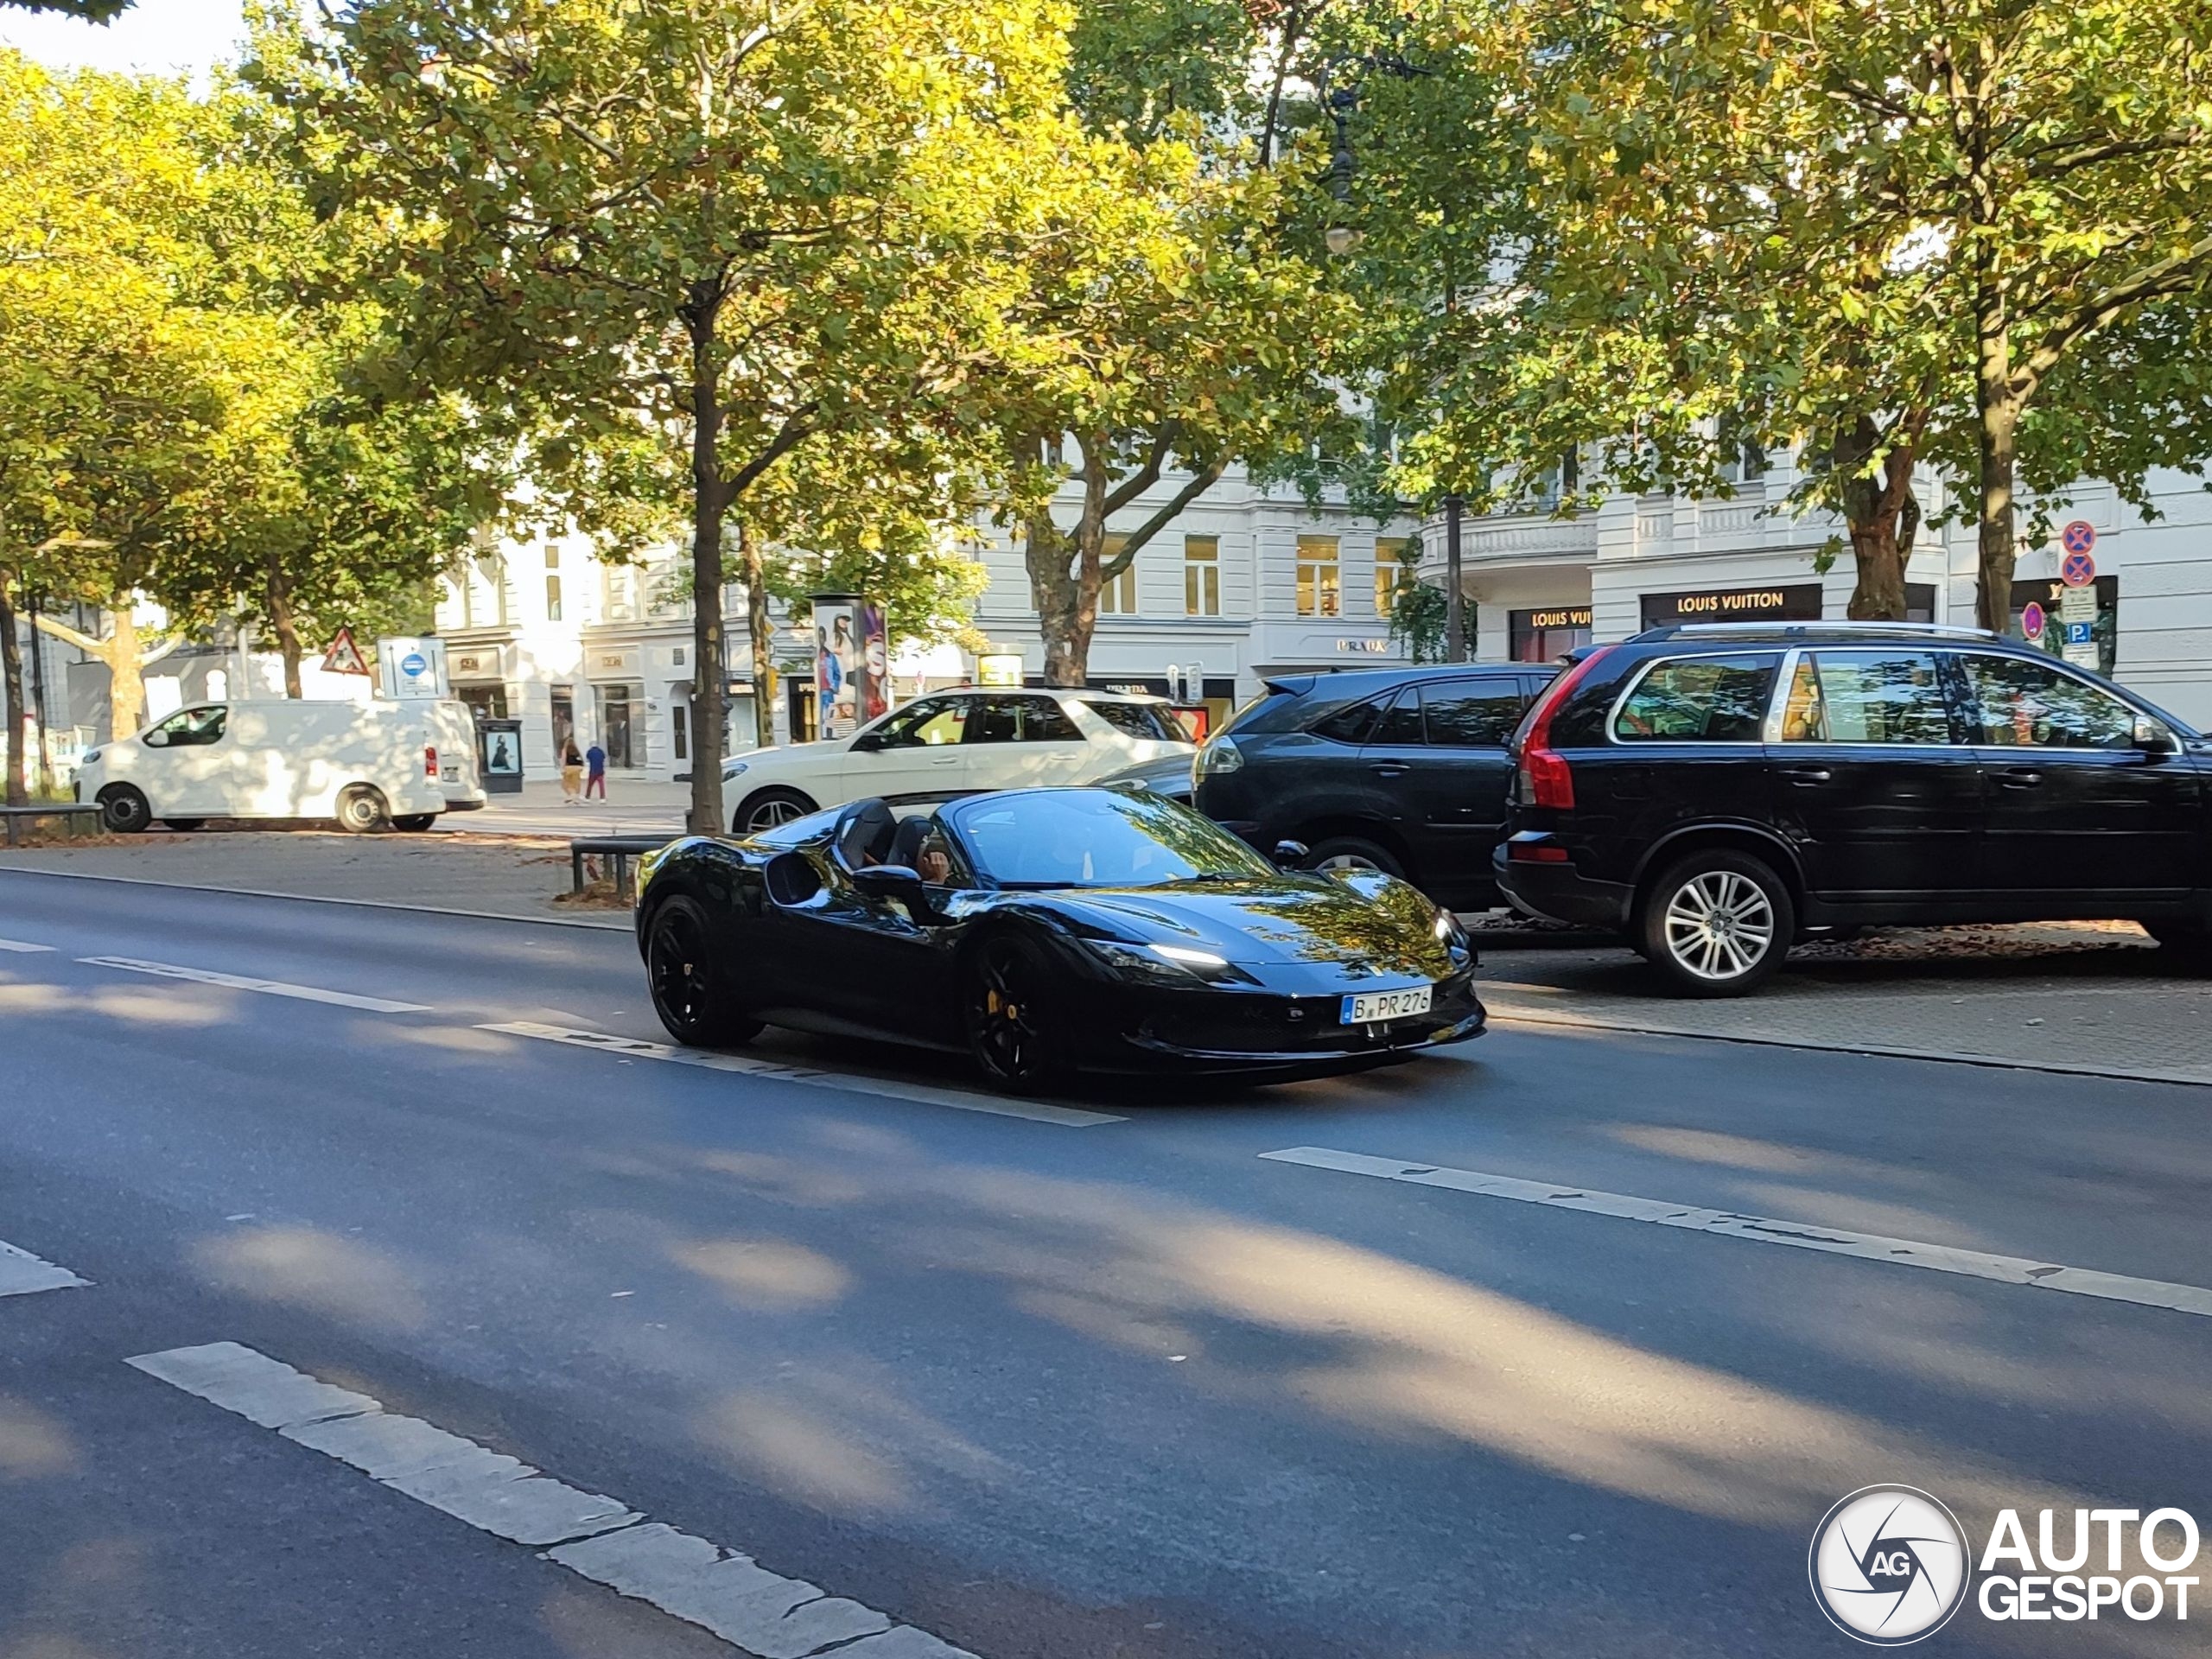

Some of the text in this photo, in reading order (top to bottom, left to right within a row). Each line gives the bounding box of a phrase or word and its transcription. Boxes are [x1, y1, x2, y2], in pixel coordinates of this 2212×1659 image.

[1678, 593, 1783, 613] LOUIS VUITTON
[1532, 612, 1567, 627] LOUIS
[1337, 639, 1387, 653] PRADA
